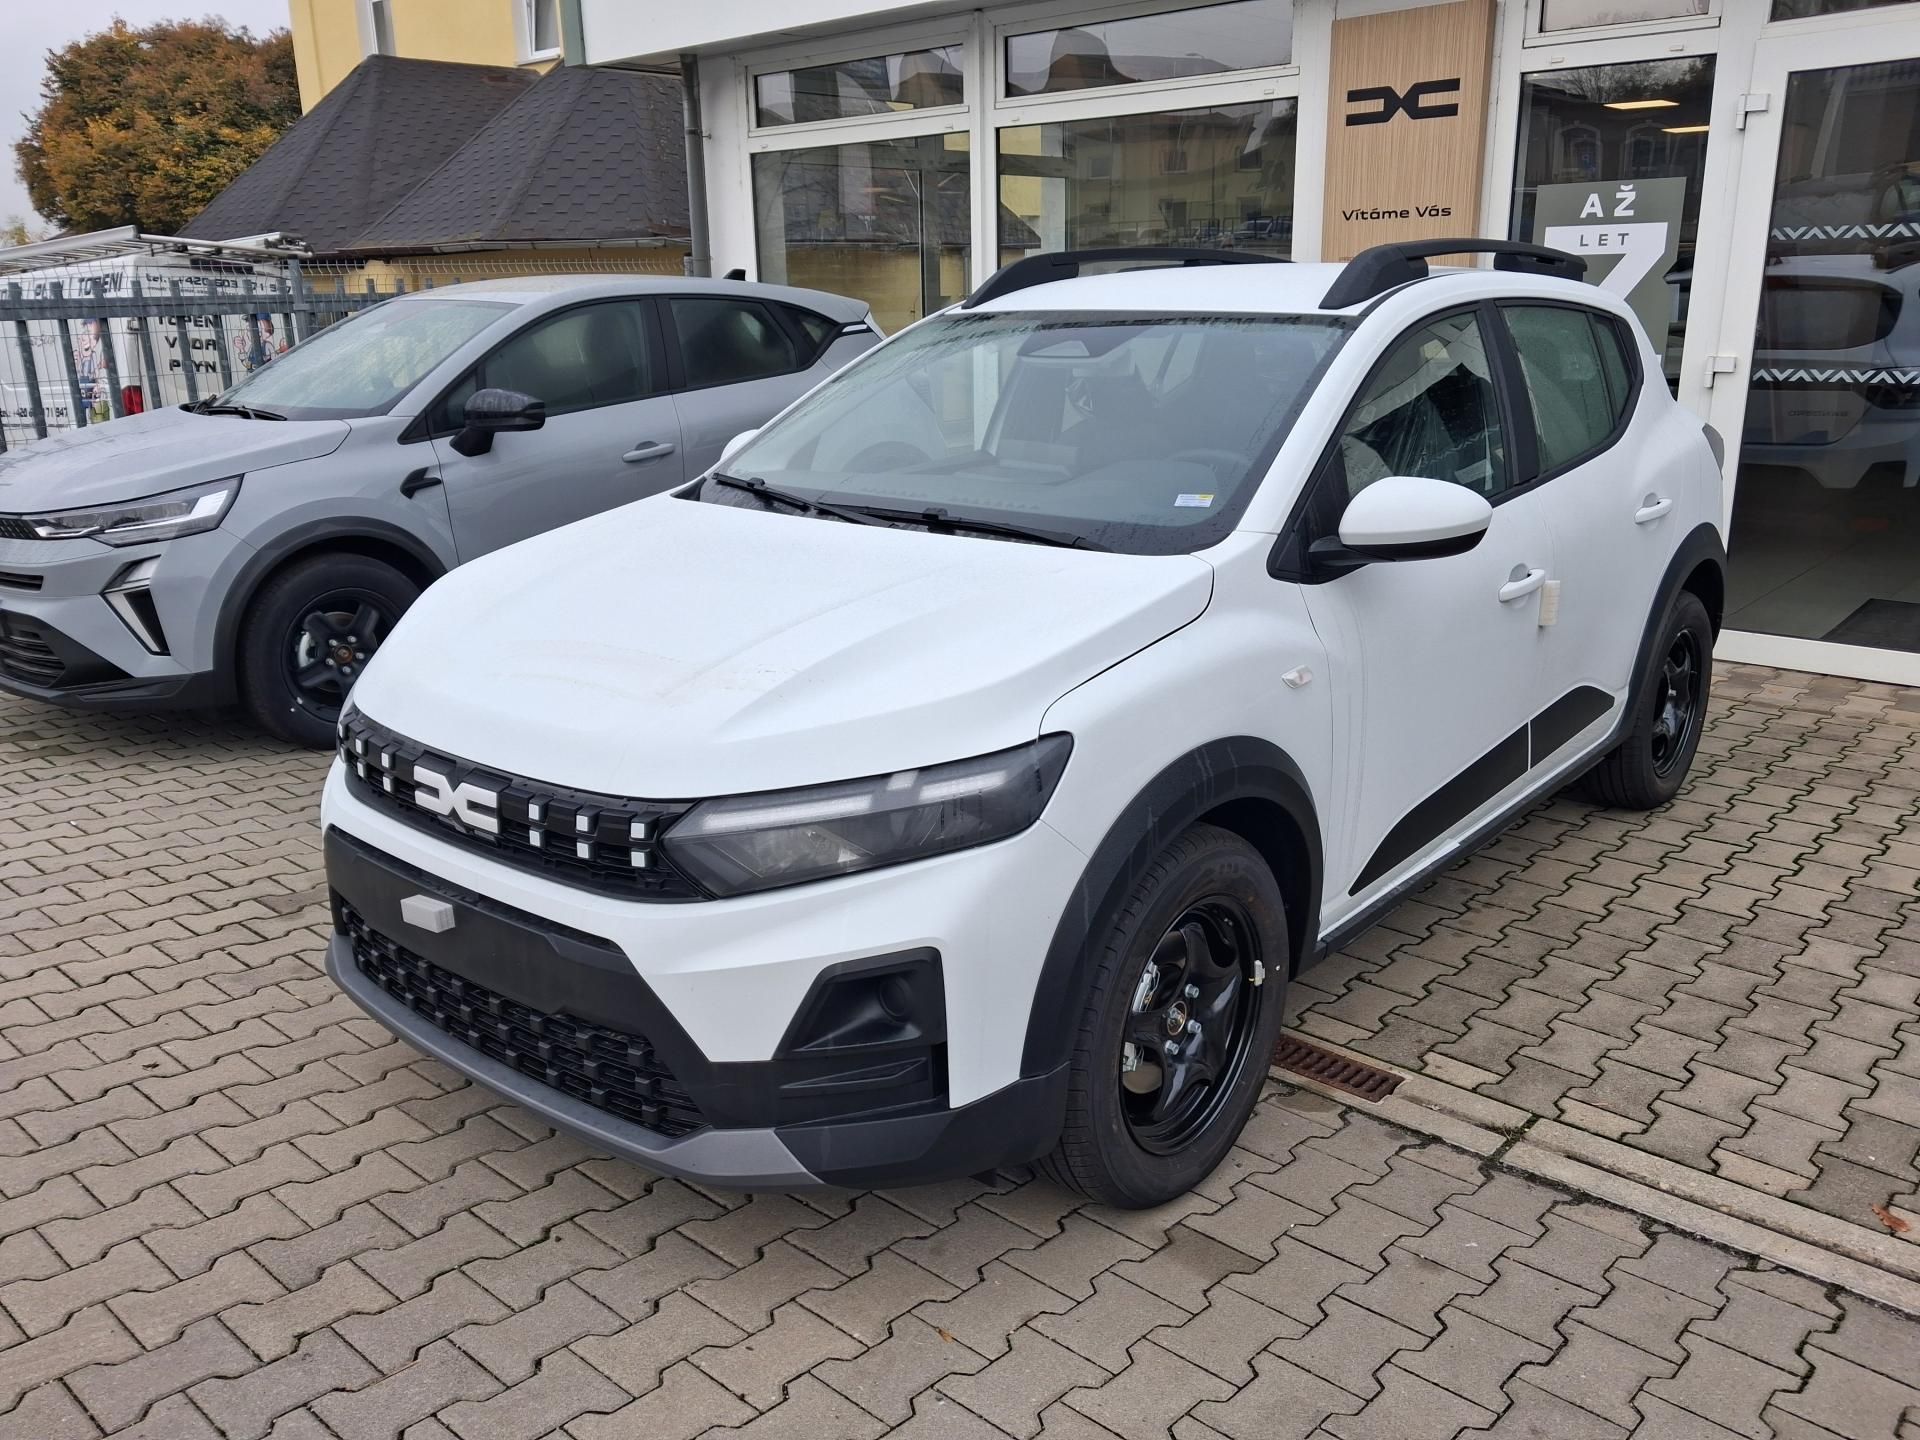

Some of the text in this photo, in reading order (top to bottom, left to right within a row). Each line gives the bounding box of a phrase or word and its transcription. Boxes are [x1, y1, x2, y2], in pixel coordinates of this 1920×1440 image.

[1579, 184, 1637, 218] AŽ
[1342, 205, 1452, 221] Vítáme Vás
[1579, 233, 1630, 247] LET
[164, 335, 217, 351] VDA
[168, 359, 217, 373] PYN
